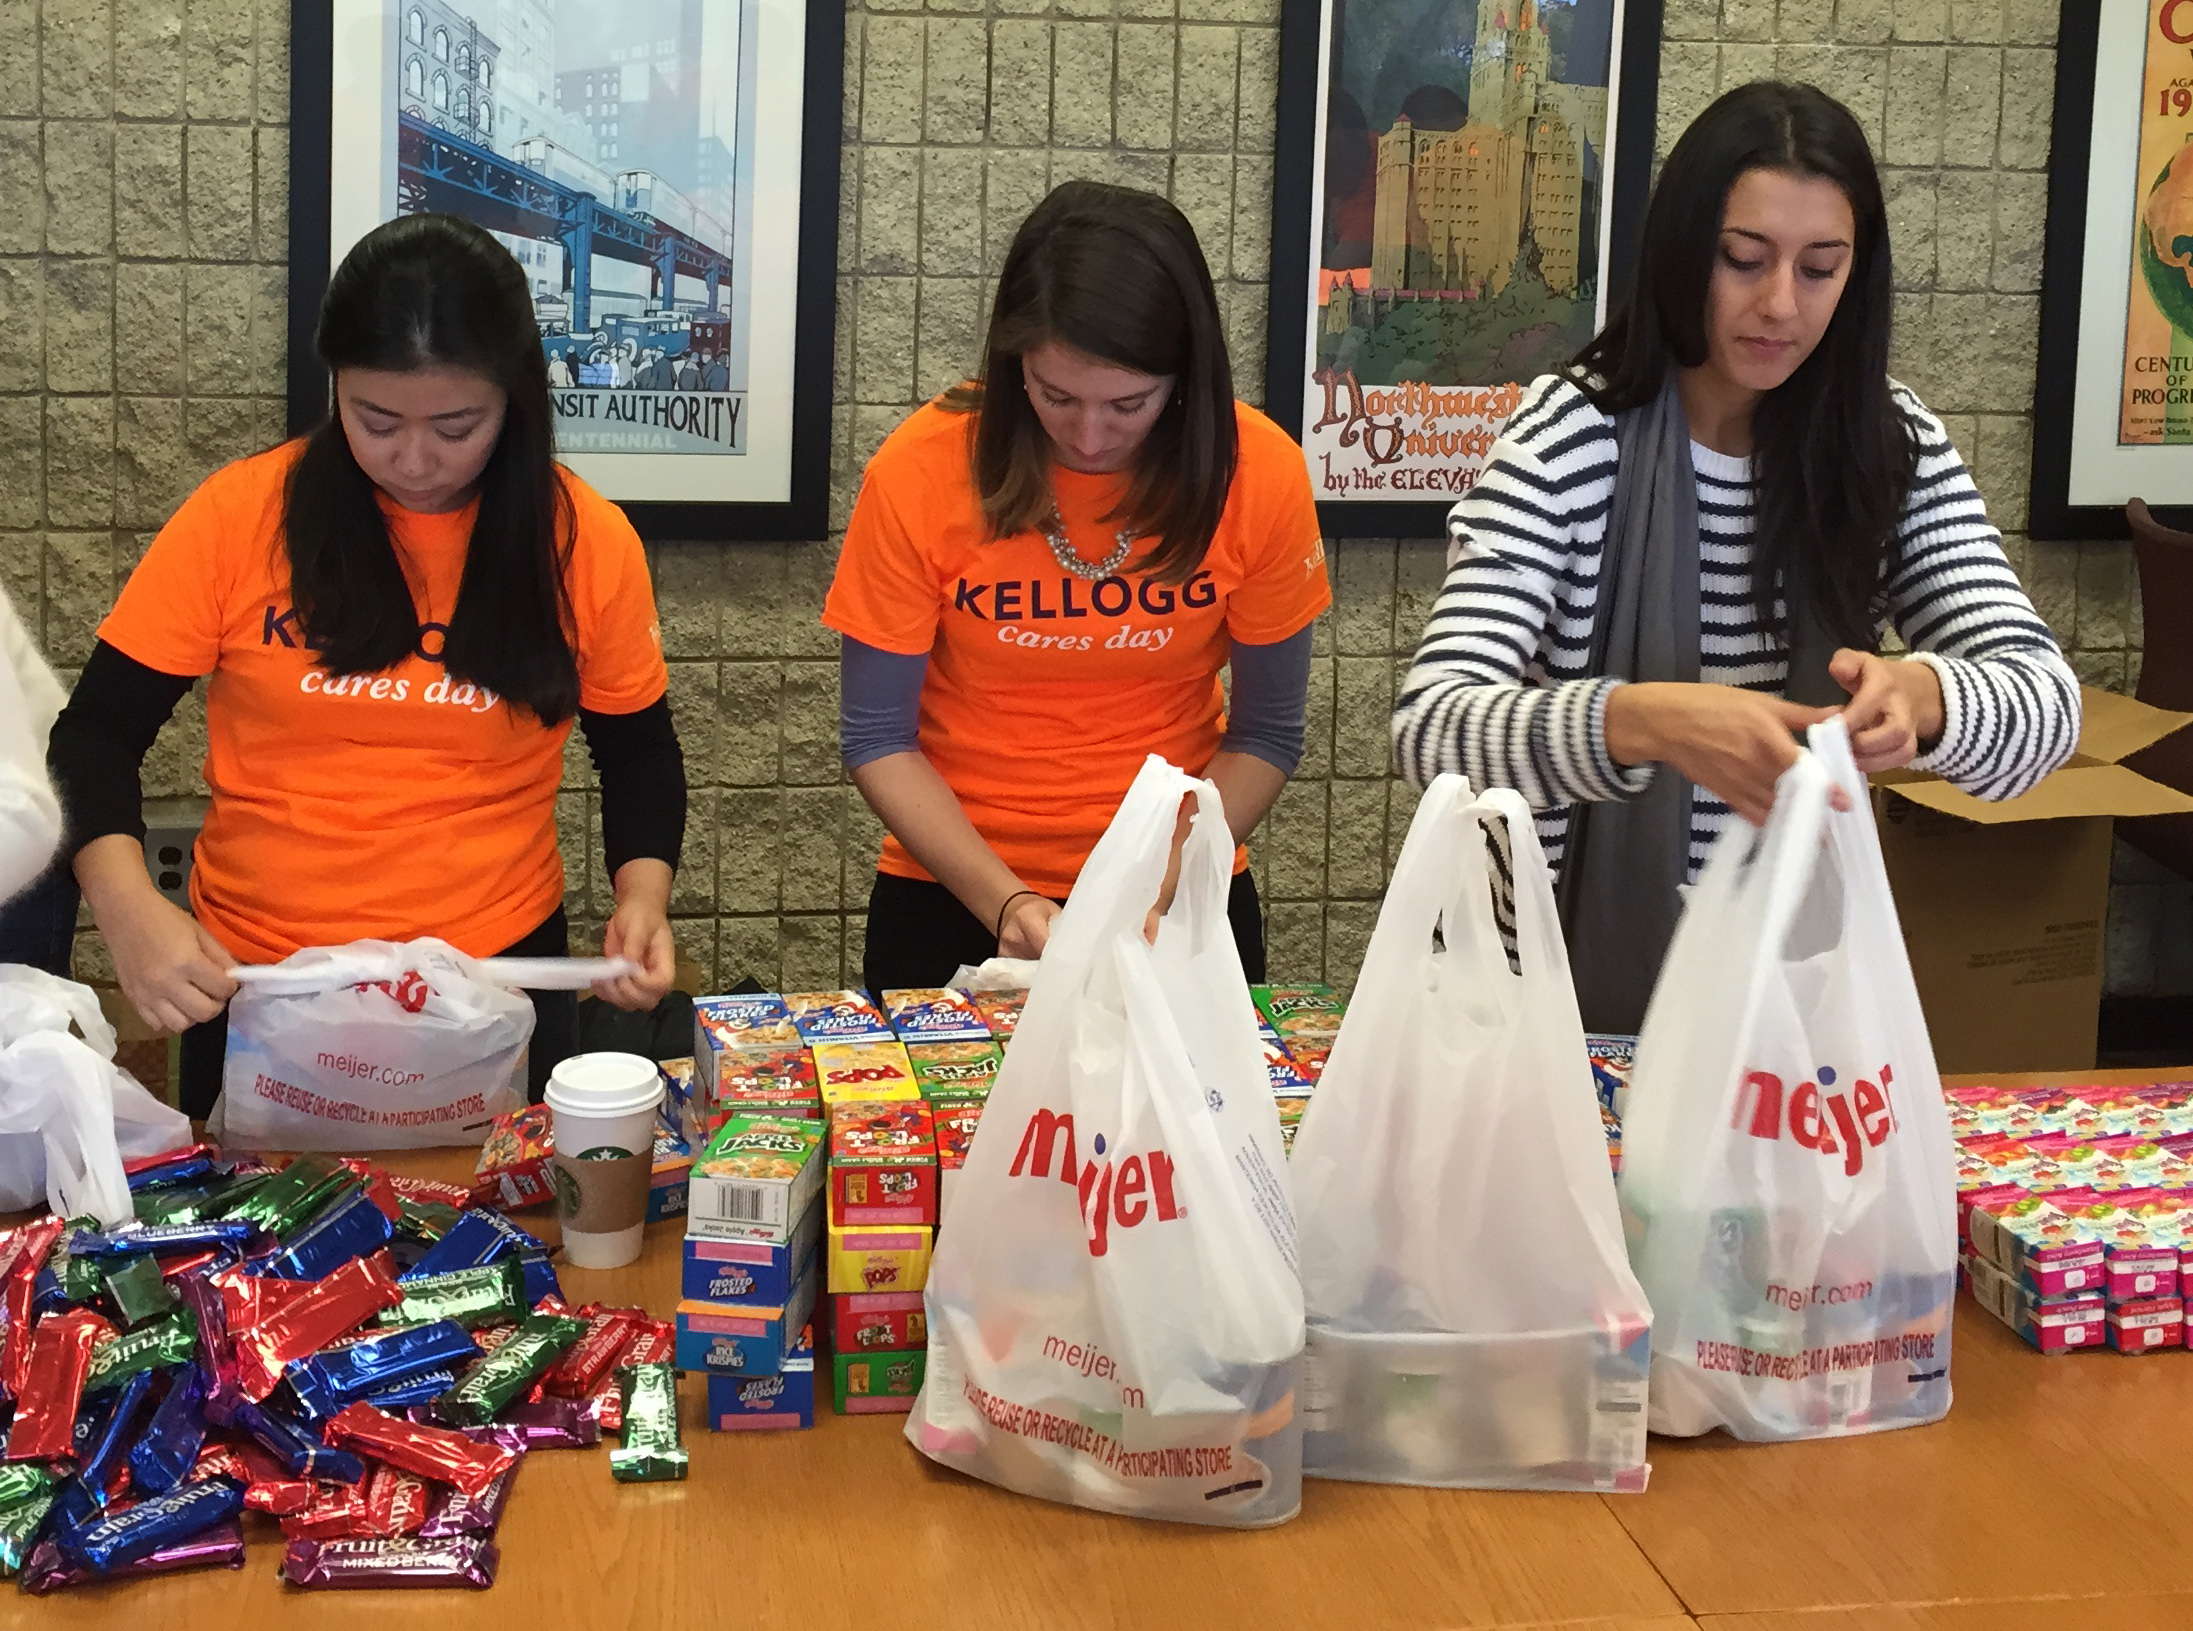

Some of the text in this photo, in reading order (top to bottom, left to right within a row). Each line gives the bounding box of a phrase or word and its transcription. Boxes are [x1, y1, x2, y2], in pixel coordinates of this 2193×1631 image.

[2159, 88, 2193, 117] 19
[2134, 356, 2193, 373] CENTU
[2166, 375, 2188, 387] OF
[1312, 366, 1523, 447] Northwest
[2132, 388, 2193, 405] PROGR
[553, 393, 741, 448] NSIT AUTHORITY
[557, 431, 678, 450] ENTENNIAL
[1363, 416, 1496, 467] Univer
[1319, 451, 1482, 497] by the ELEVA
[954, 570, 1217, 621] KELLOGG
[998, 624, 1174, 652] cares day
[300, 671, 500, 713] cares day
[318, 1052, 424, 1086] meijer.com
[826, 1065, 905, 1085] POPS
[255, 1073, 286, 1104] PLEASE
[285, 1085, 315, 1113] REUSE
[313, 1096, 327, 1117] OR
[390, 1103, 456, 1127] PARTICIPATING
[456, 1093, 485, 1119] STORE
[709, 1277, 753, 1290] FROSTED
[710, 1286, 748, 1298] FLAKES
[865, 1268, 901, 1289] POPS
[582, 1322, 628, 1375] STRAWBERRY
[1901, 1333, 1934, 1360] STORE
[1023, 1409, 1041, 1439] OR
[1041, 1413, 1093, 1453] RECYCLE
[1091, 1433, 1108, 1462] AT
[1104, 1439, 1116, 1468] A
[1196, 1445, 1232, 1476] STORE
[343, 1556, 396, 1569] MIXED
